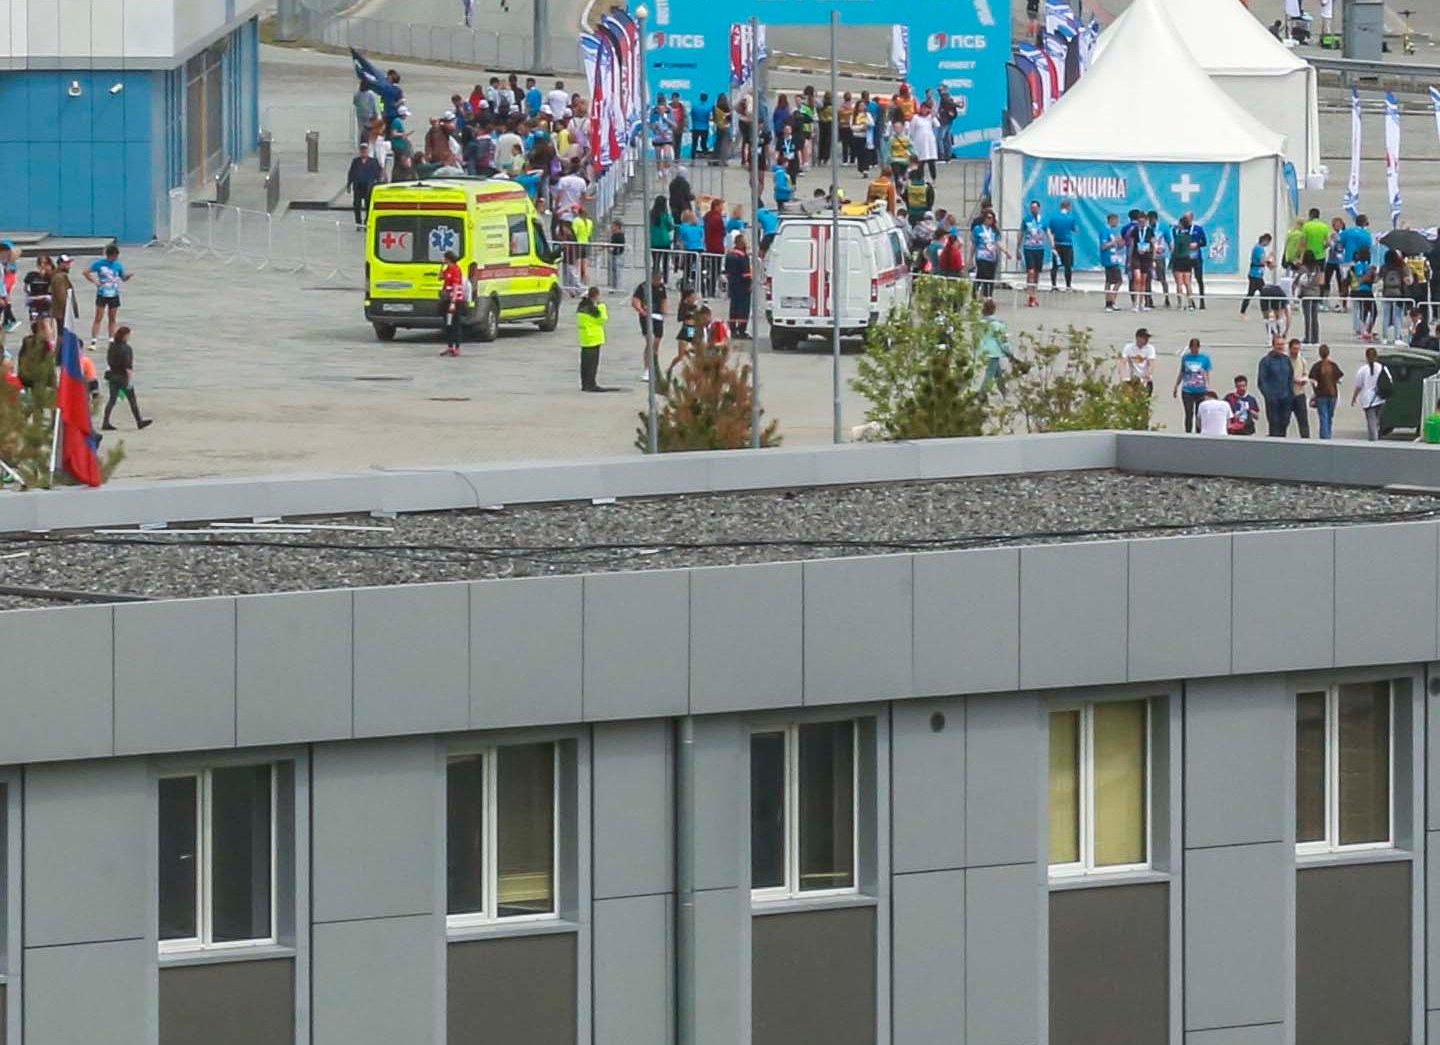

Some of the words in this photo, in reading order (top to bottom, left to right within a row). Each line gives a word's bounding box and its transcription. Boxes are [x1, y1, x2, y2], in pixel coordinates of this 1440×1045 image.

[668, 34, 705, 48] ПСБ
[951, 35, 986, 49] ПСБ
[1047, 174, 1128, 200] МЕДИЦИНА
